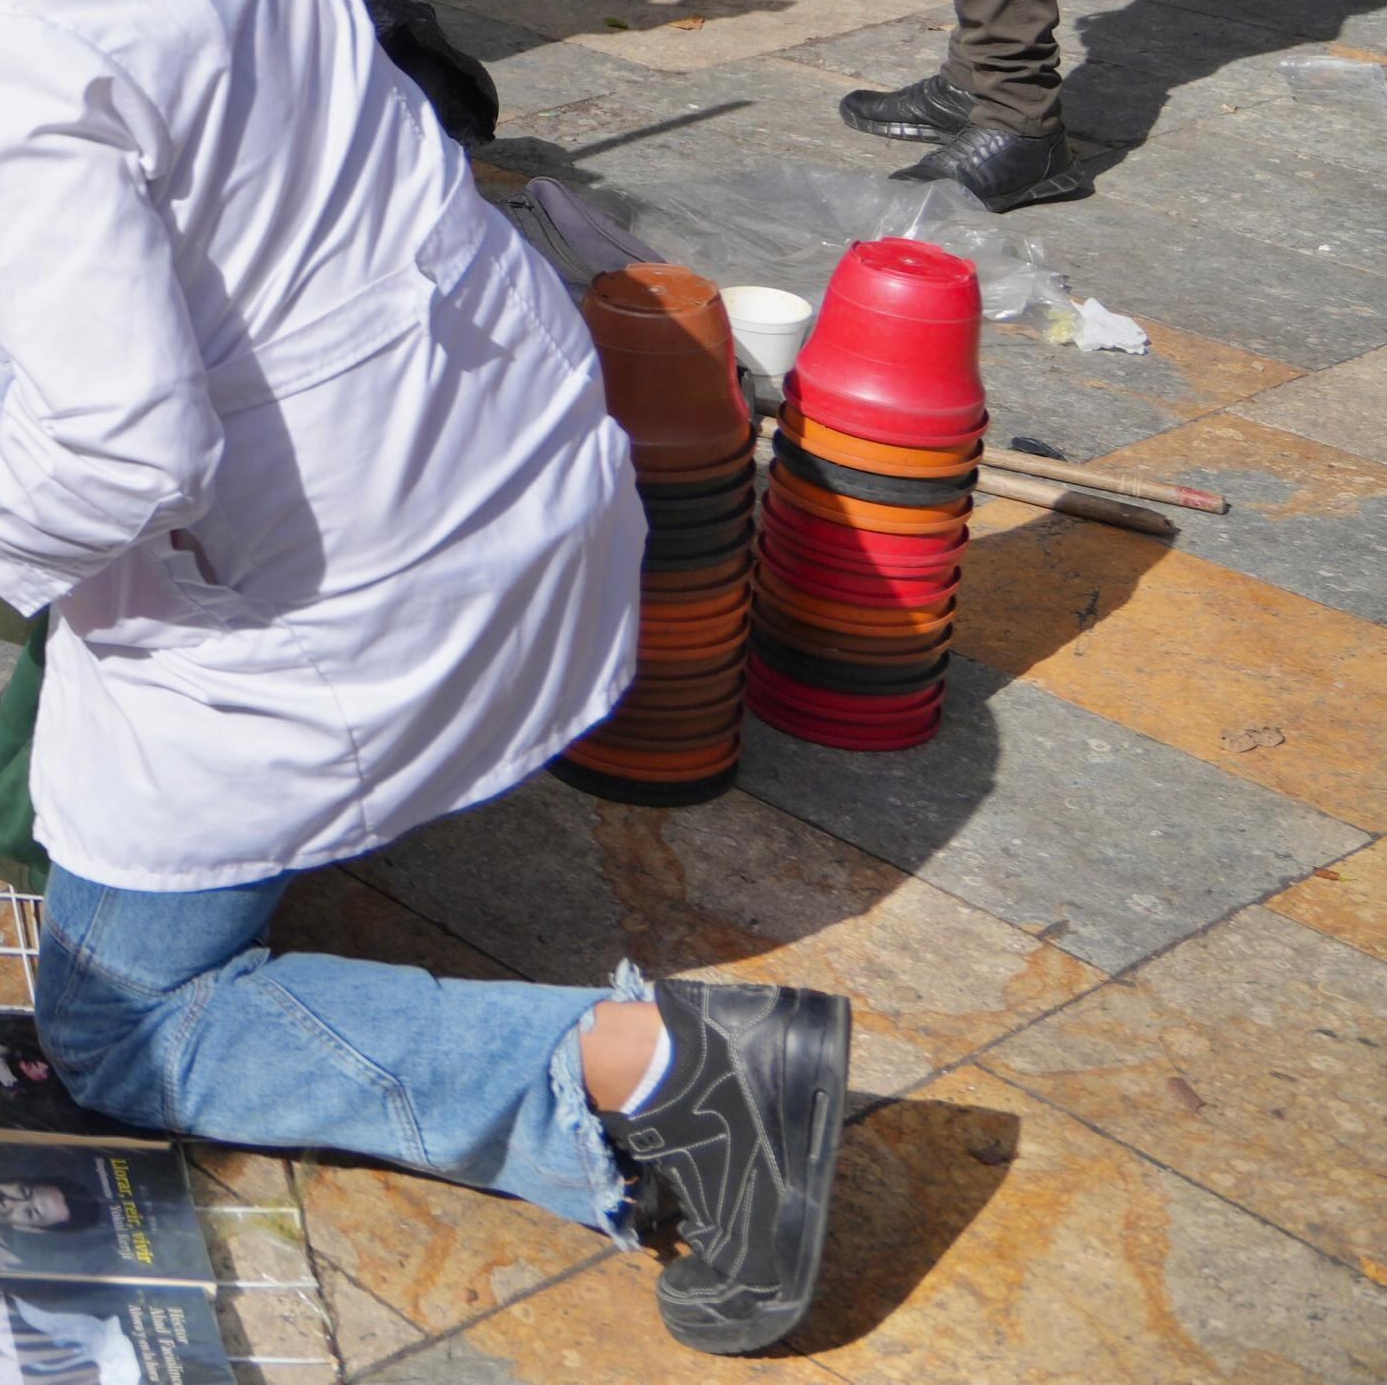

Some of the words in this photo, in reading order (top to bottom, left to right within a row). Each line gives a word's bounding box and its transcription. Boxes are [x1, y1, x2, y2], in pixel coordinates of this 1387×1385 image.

[110, 1158, 133, 1199] Llorar,
[149, 1306, 169, 1336] Abad
[168, 1307, 189, 1345] Héctor
